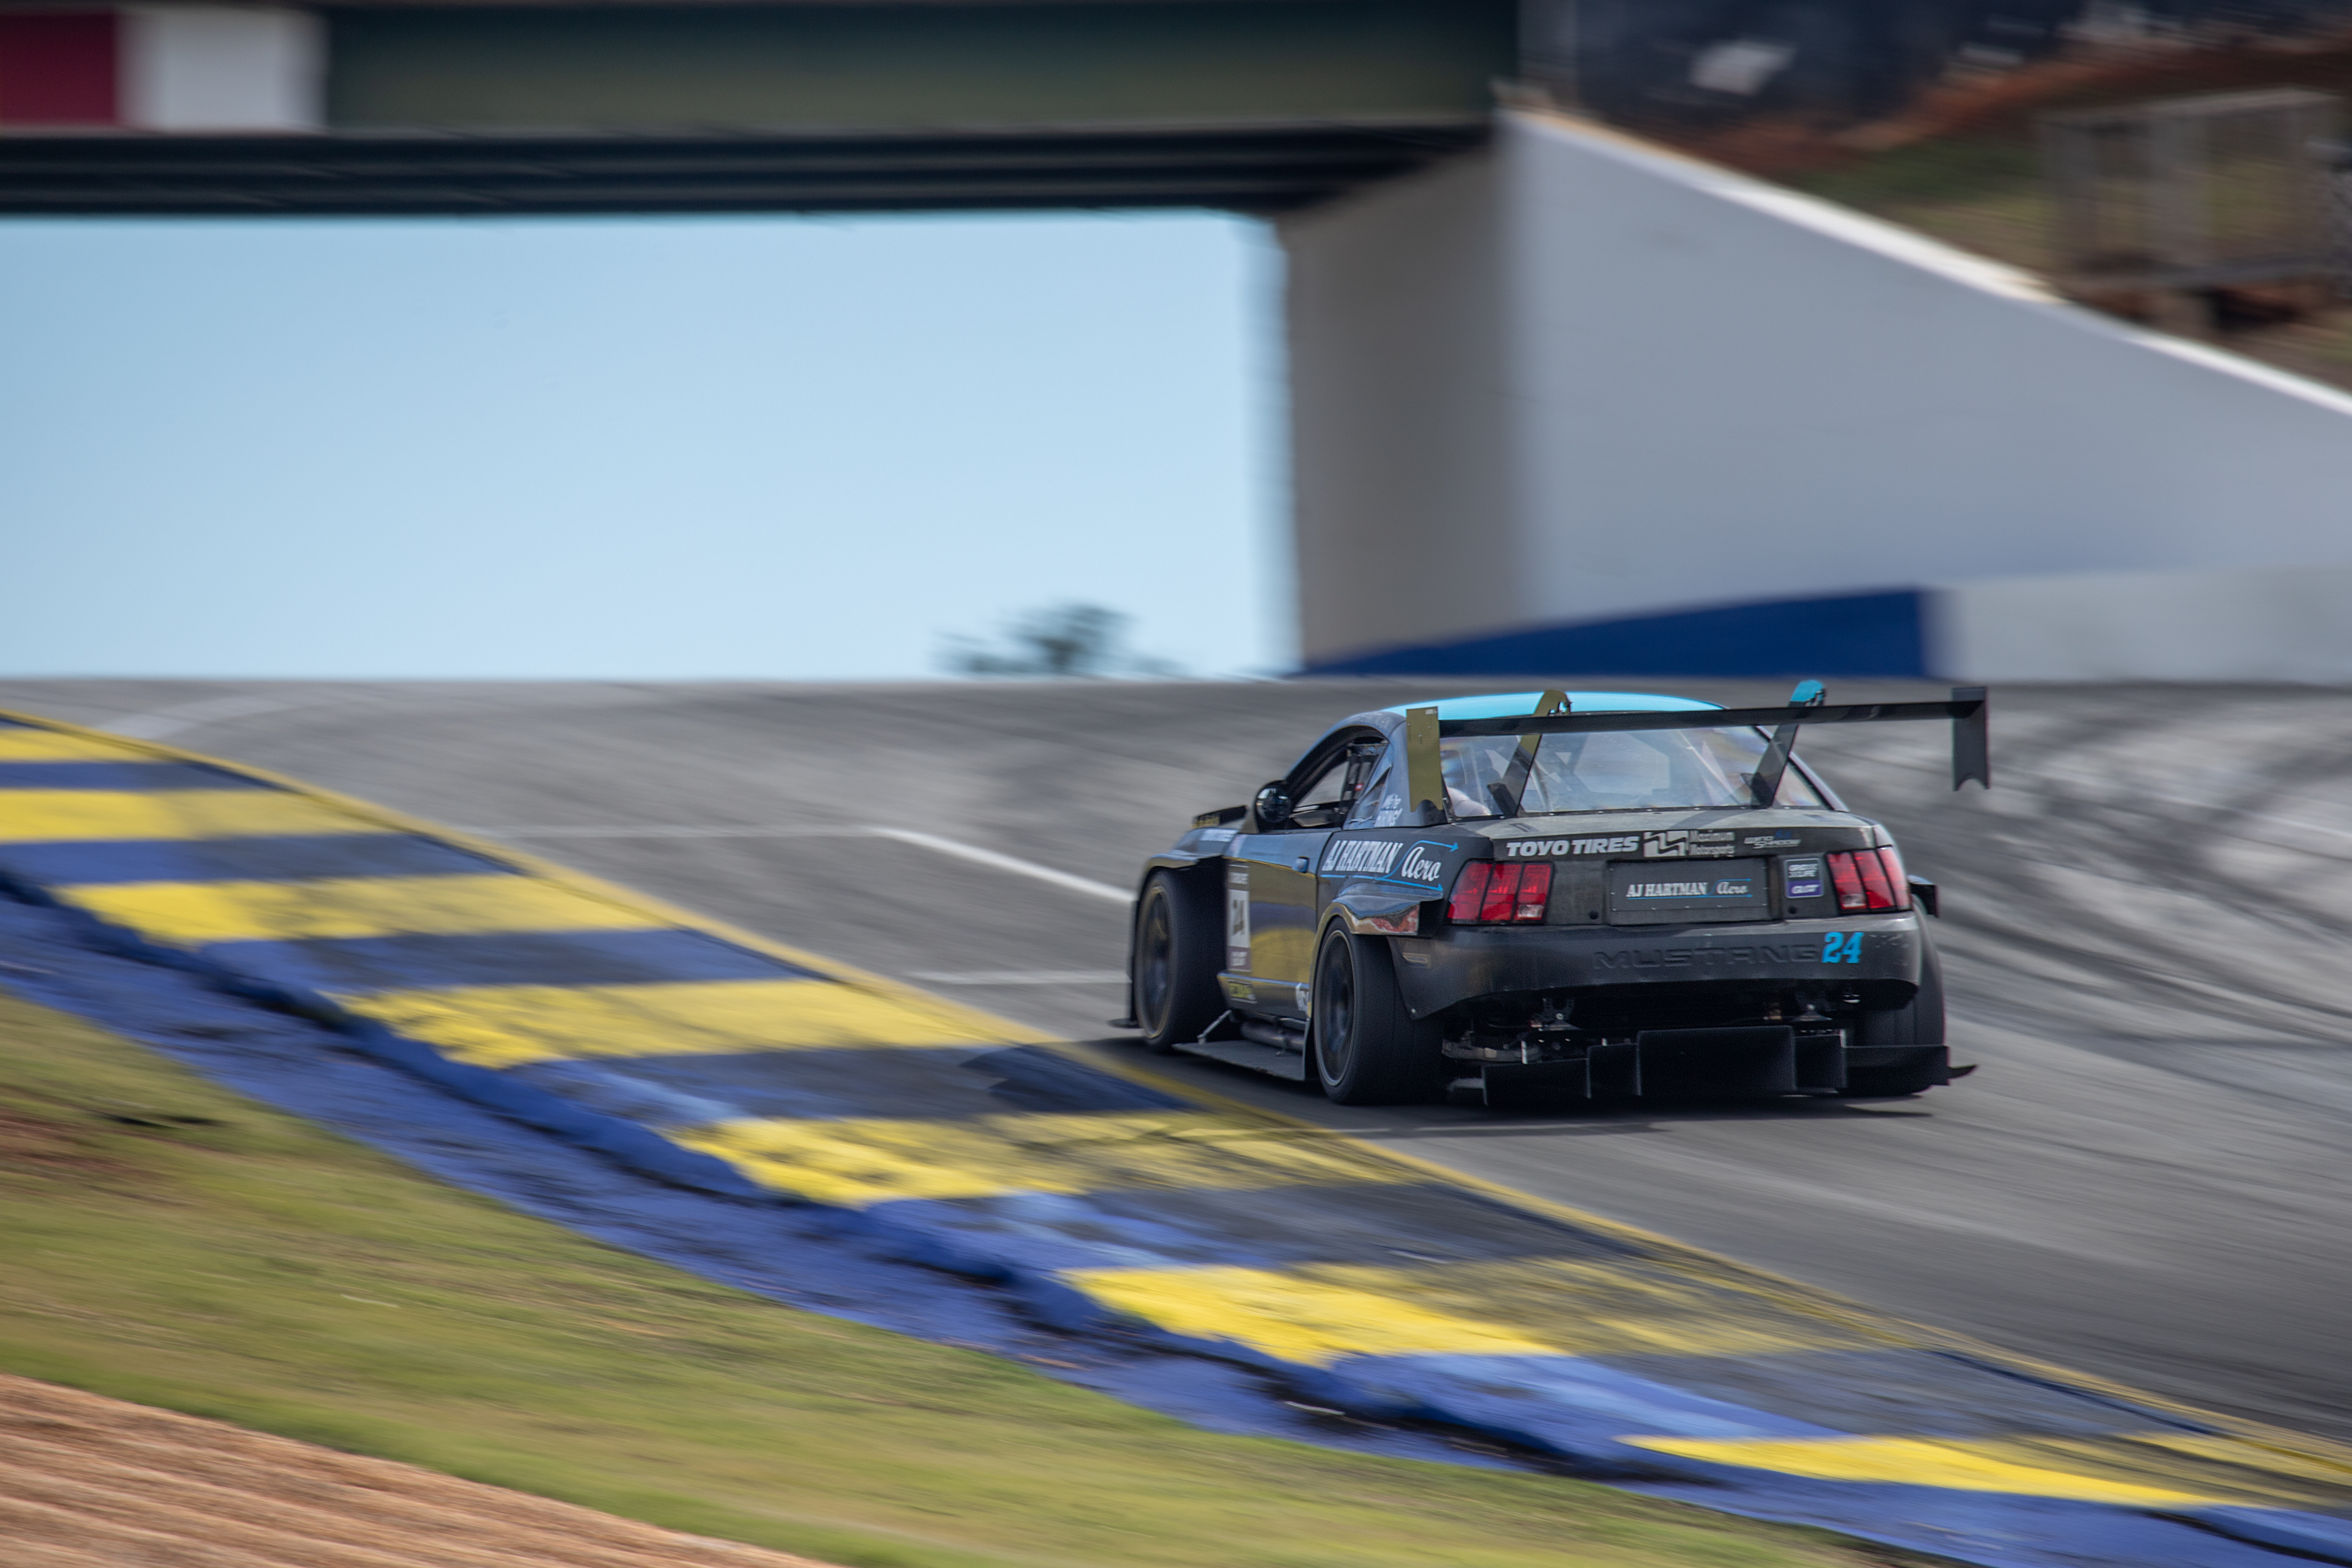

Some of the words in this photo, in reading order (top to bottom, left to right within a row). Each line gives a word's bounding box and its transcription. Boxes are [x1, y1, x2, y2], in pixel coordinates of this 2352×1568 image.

[1506, 840, 1570, 856] TOYO
[1571, 836, 1640, 854] TIRES
[1335, 840, 1404, 874] HARTMAN
[1401, 846, 1441, 882] Aero
[1626, 884, 1643, 897] AJ
[1644, 882, 1708, 897] HARTMAN
[1716, 881, 1748, 894] Aero
[1594, 943, 1819, 969] MUSTANG
[1821, 931, 1864, 963] 24
